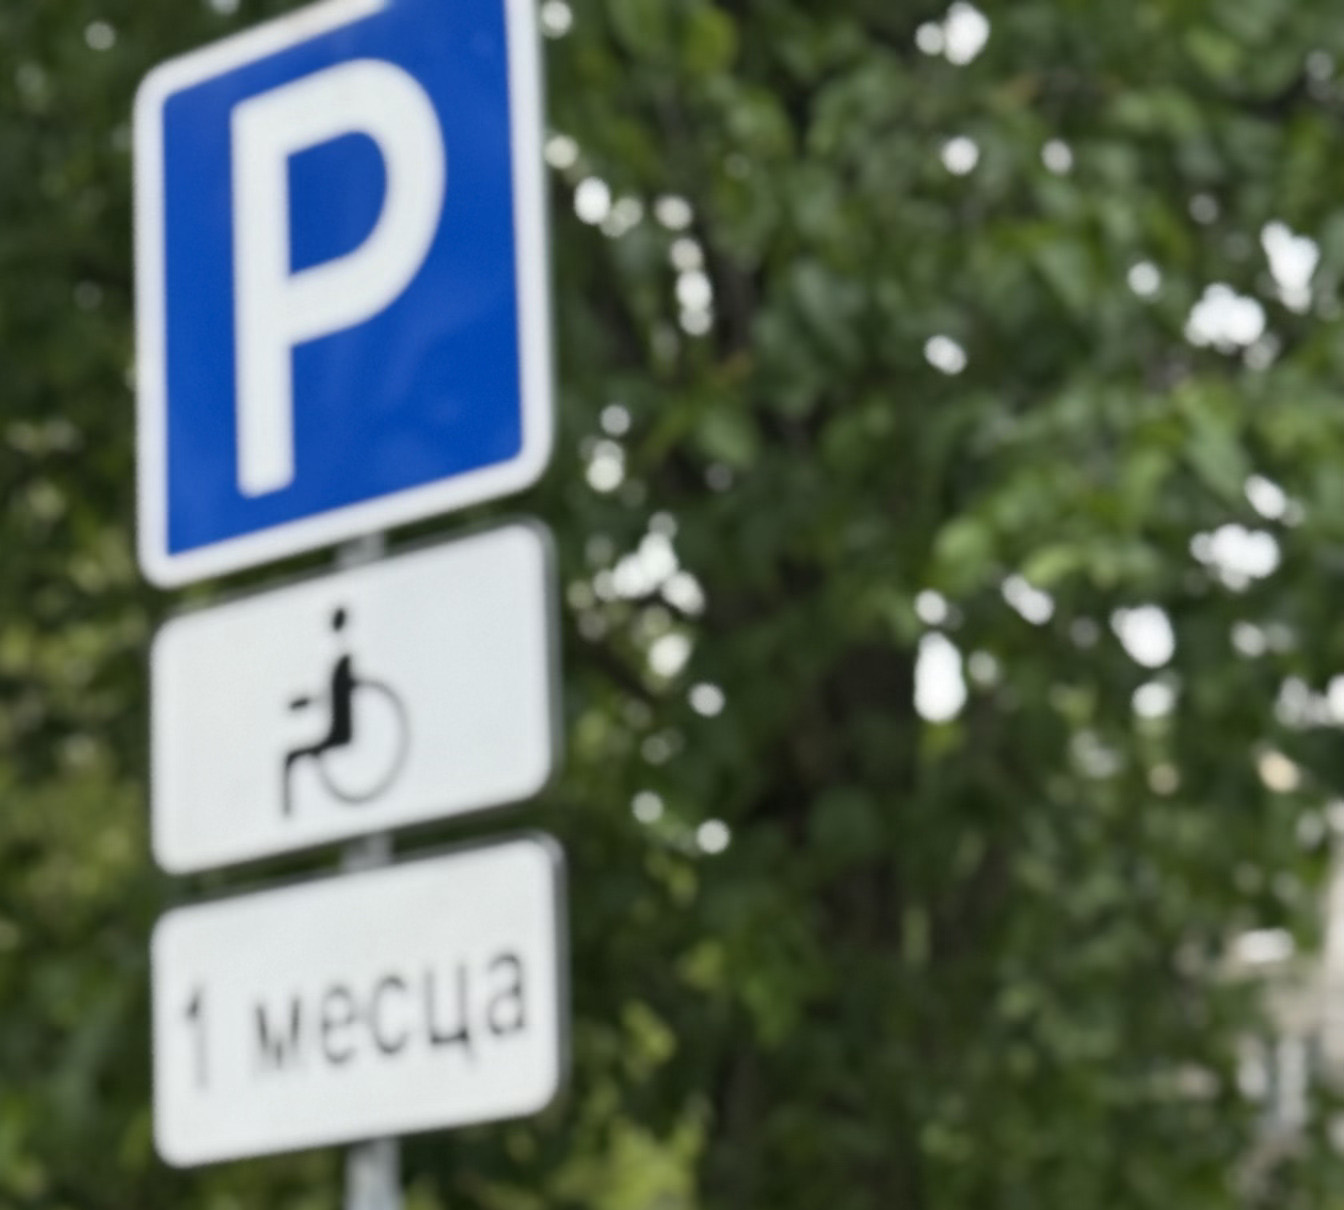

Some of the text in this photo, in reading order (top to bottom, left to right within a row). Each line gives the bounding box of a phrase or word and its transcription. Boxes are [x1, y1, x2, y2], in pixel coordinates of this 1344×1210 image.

[229, 57, 447, 499] P
[185, 952, 526, 1092] 1 месца
